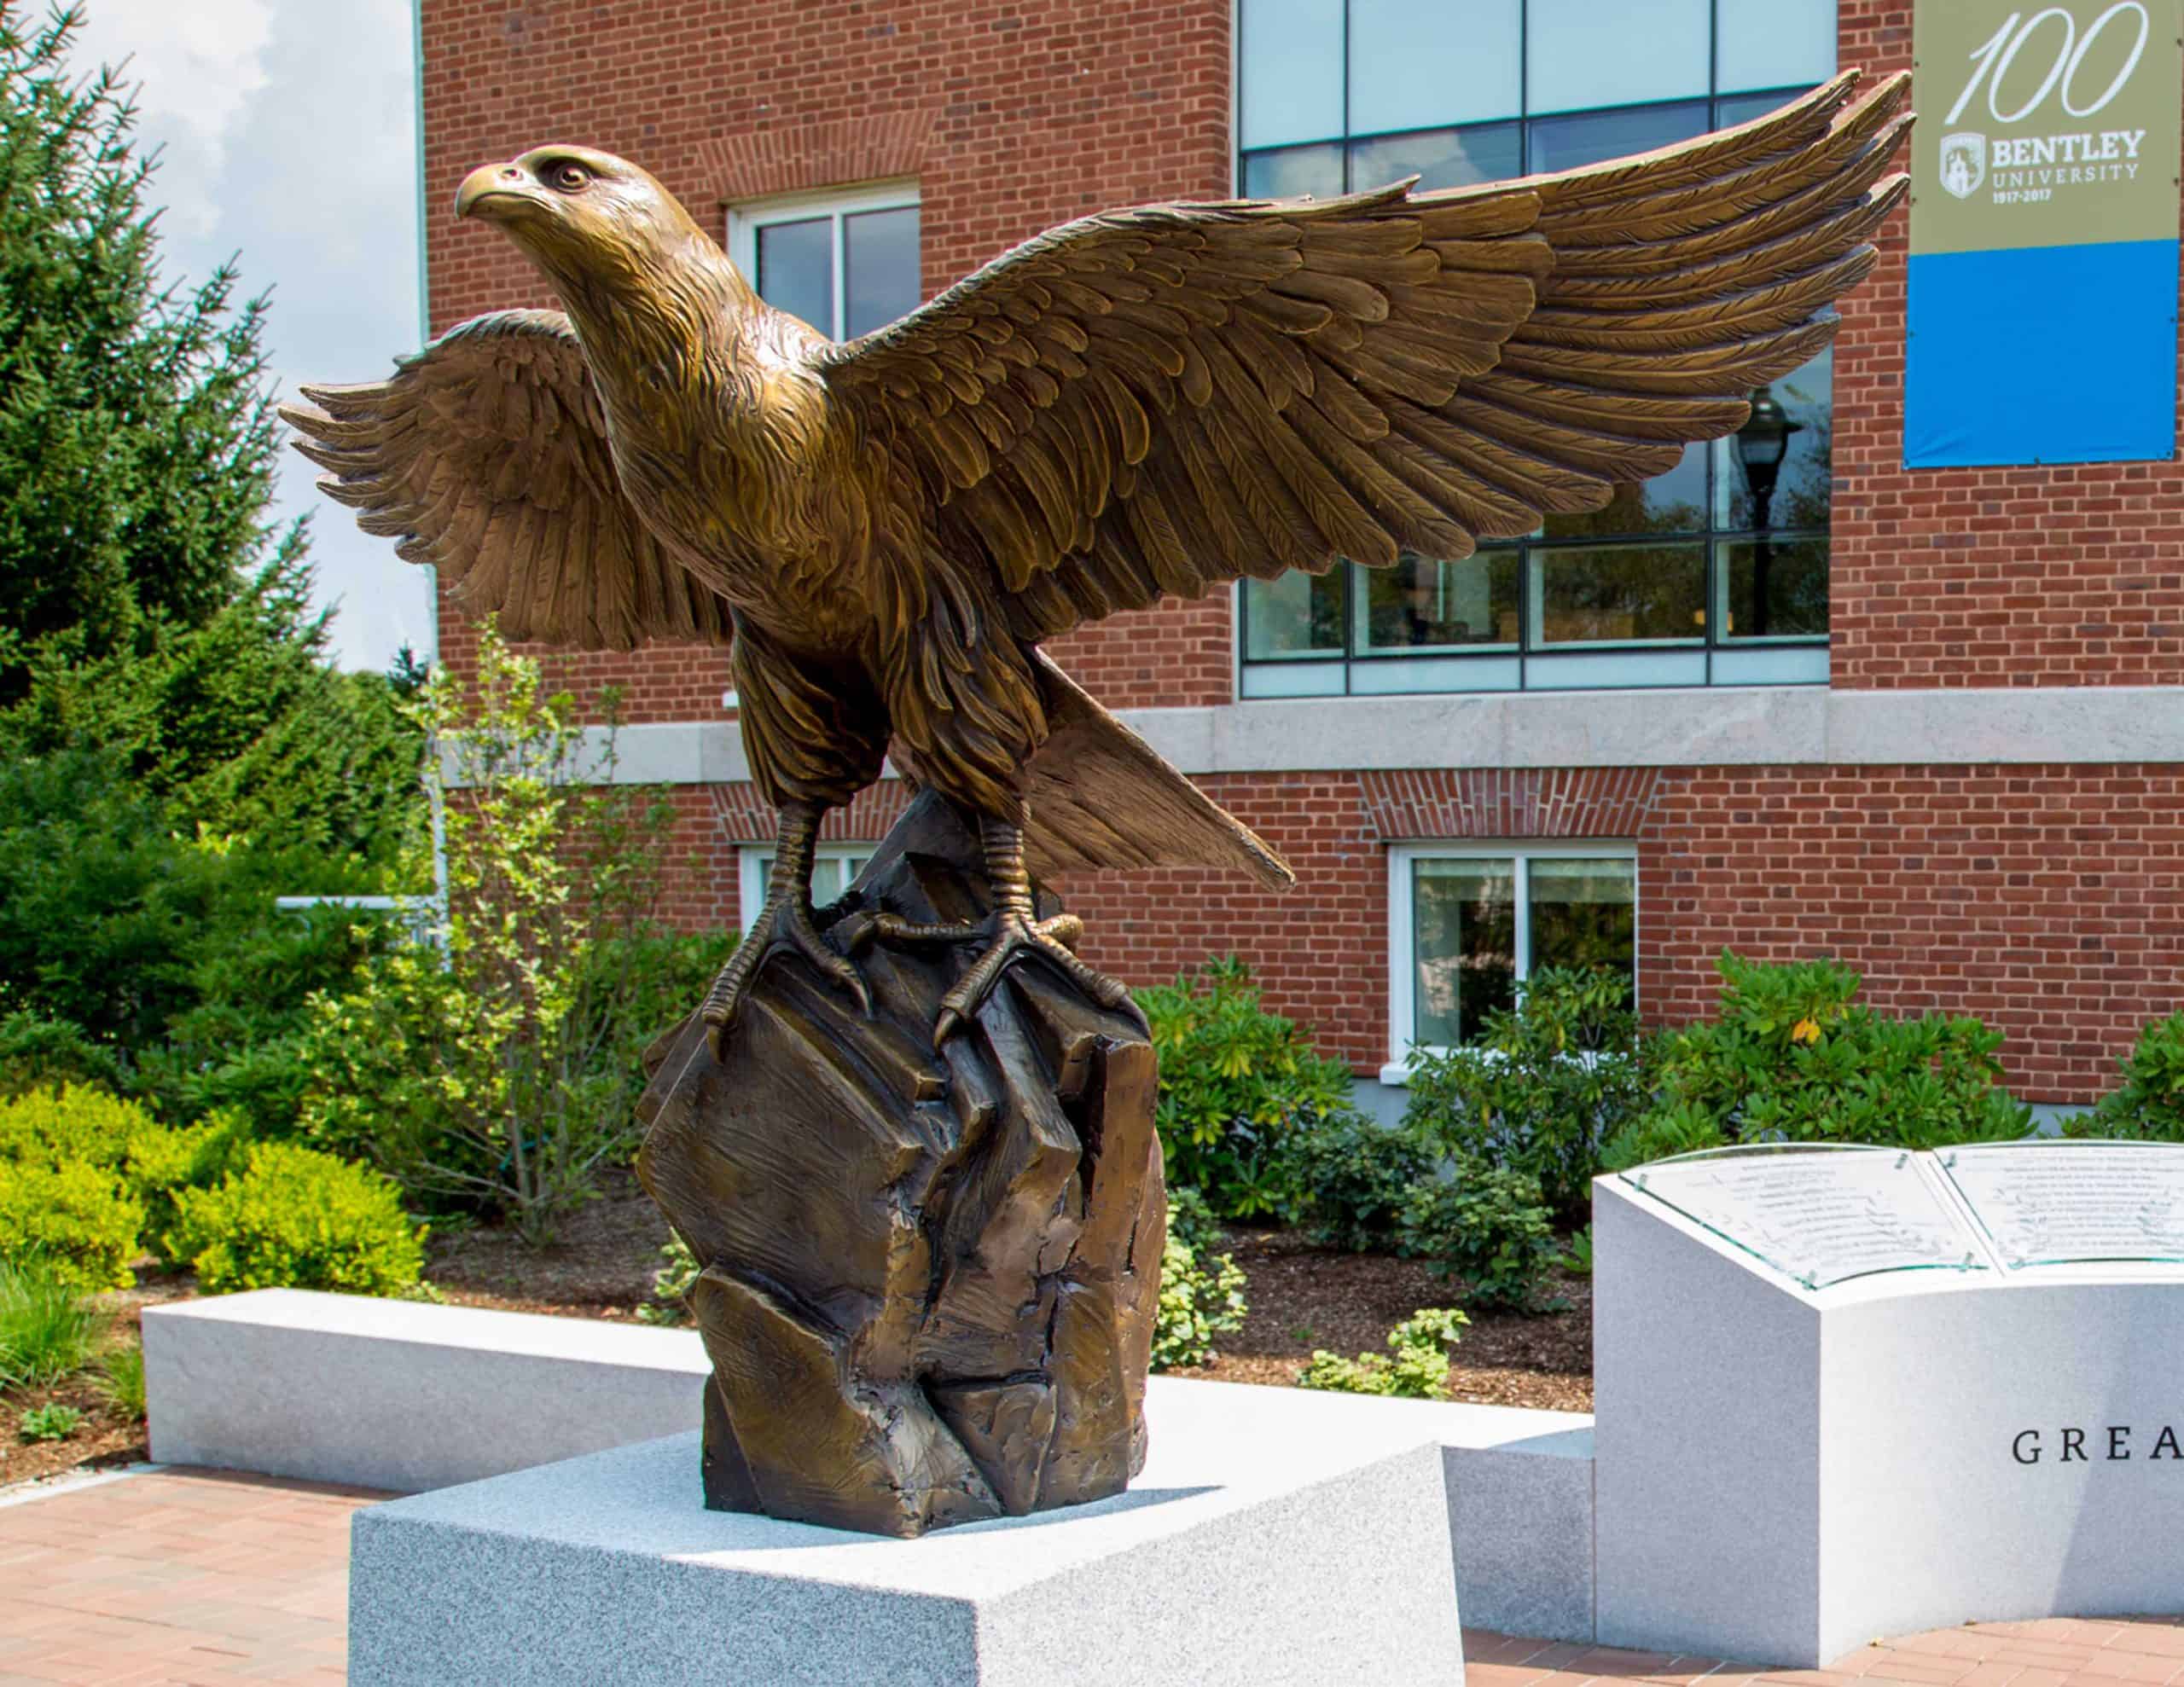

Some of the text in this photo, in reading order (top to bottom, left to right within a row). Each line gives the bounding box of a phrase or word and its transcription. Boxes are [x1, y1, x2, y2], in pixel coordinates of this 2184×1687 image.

[1943, 1, 2149, 125] 100
[1992, 130, 2146, 168] BENTLEY
[1992, 163, 2139, 189] UNIVERSITY
[1992, 188, 2052, 205] 1917-2017
[2013, 1426, 2184, 1464] GREA
